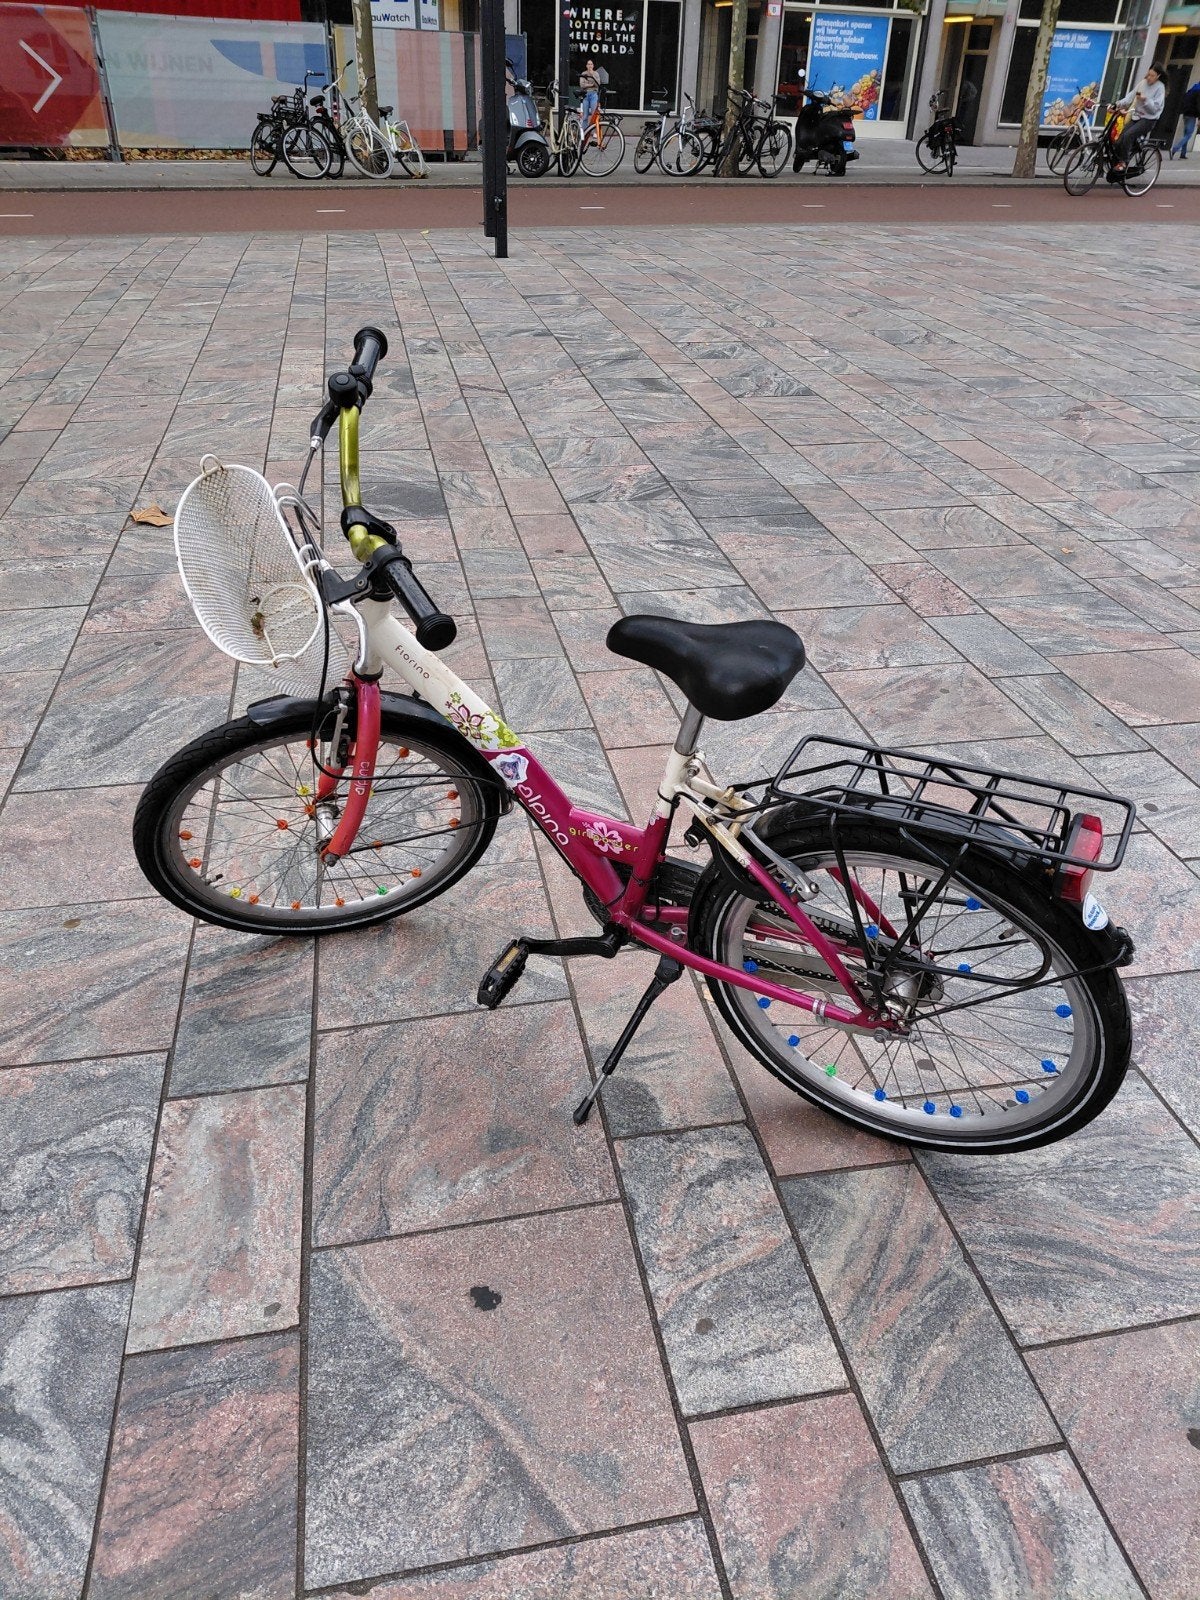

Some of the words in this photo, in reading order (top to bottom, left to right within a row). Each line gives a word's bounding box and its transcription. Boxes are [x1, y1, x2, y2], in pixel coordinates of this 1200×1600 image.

[371, 13, 410, 22] auWatch
[816, 18, 849, 27] Binnenkort
[826, 27, 838, 35] hier
[616, 33, 636, 42] THE
[815, 35, 841, 43] nieuwste
[580, 43, 626, 54] WORLD
[814, 42, 833, 50] Albert
[834, 43, 849, 51] Heijn
[518, 784, 569, 845] alpino
